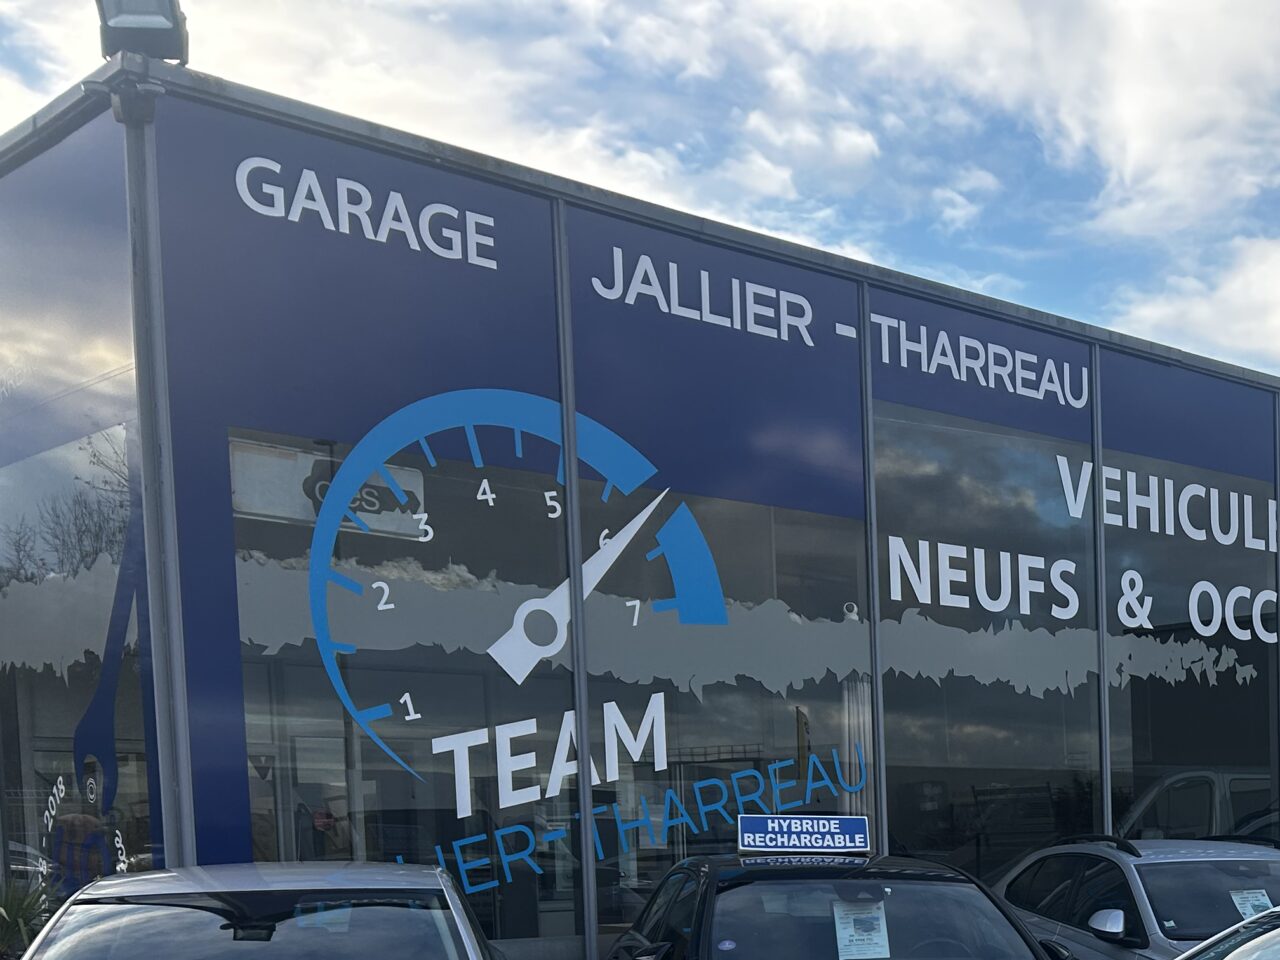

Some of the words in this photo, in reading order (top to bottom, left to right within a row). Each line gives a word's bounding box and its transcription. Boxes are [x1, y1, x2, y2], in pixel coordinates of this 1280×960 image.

[235, 157, 498, 270] GARAGE
[591, 246, 815, 347] JALLIER
[871, 312, 1089, 409] THARREAU
[475, 479, 497, 507] 4
[543, 491, 562, 519] 5
[412, 513, 434, 542] 3
[371, 581, 396, 611] 2
[888, 536, 1080, 620] NEUFS
[1117, 569, 1153, 629] &
[625, 600, 641, 628] 7
[399, 691, 422, 720] 1
[432, 692, 668, 819] TEAM
[43, 776, 66, 833] 2018
[743, 833, 865, 847] RECHARGABLE
[767, 819, 841, 832] HYBRIDE
